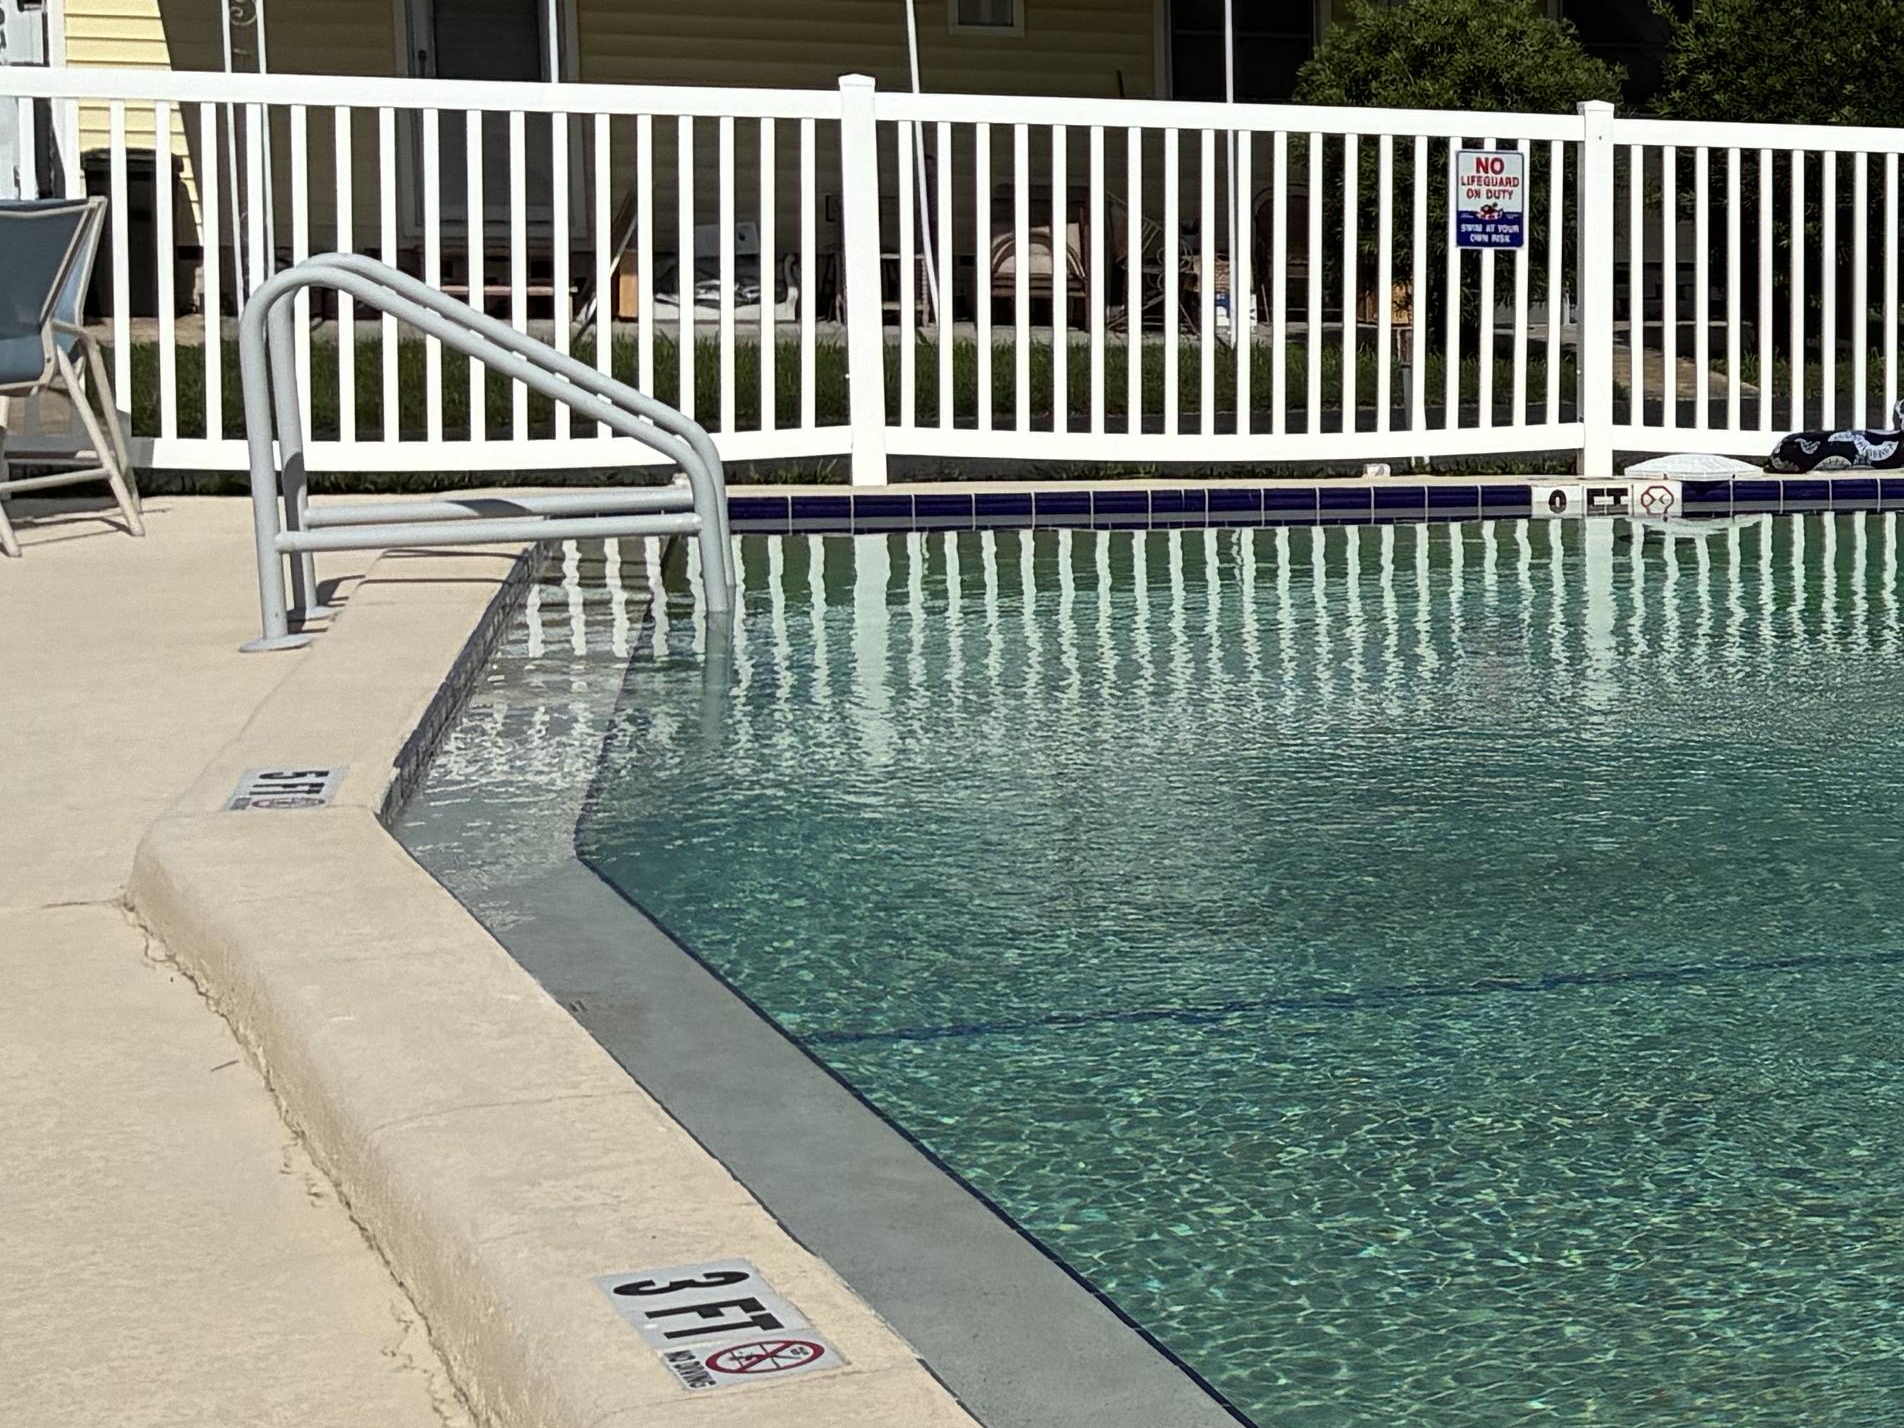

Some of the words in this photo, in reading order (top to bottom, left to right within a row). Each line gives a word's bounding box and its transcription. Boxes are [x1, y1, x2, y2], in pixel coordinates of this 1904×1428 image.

[1475, 157, 1505, 175] NO
[1461, 176, 1520, 187] LIFEGUARD
[1466, 189, 1481, 199] ON
[1486, 189, 1514, 200] DUTY
[1460, 224, 1482, 232] SWIM
[1485, 224, 1495, 233] AT
[1498, 224, 1520, 233] YOUR
[1470, 234, 1489, 242] OWN
[1491, 234, 1510, 243] RISK
[250, 782, 326, 795] FT
[613, 1271, 750, 1296] 3
[644, 1297, 785, 1339] FT
